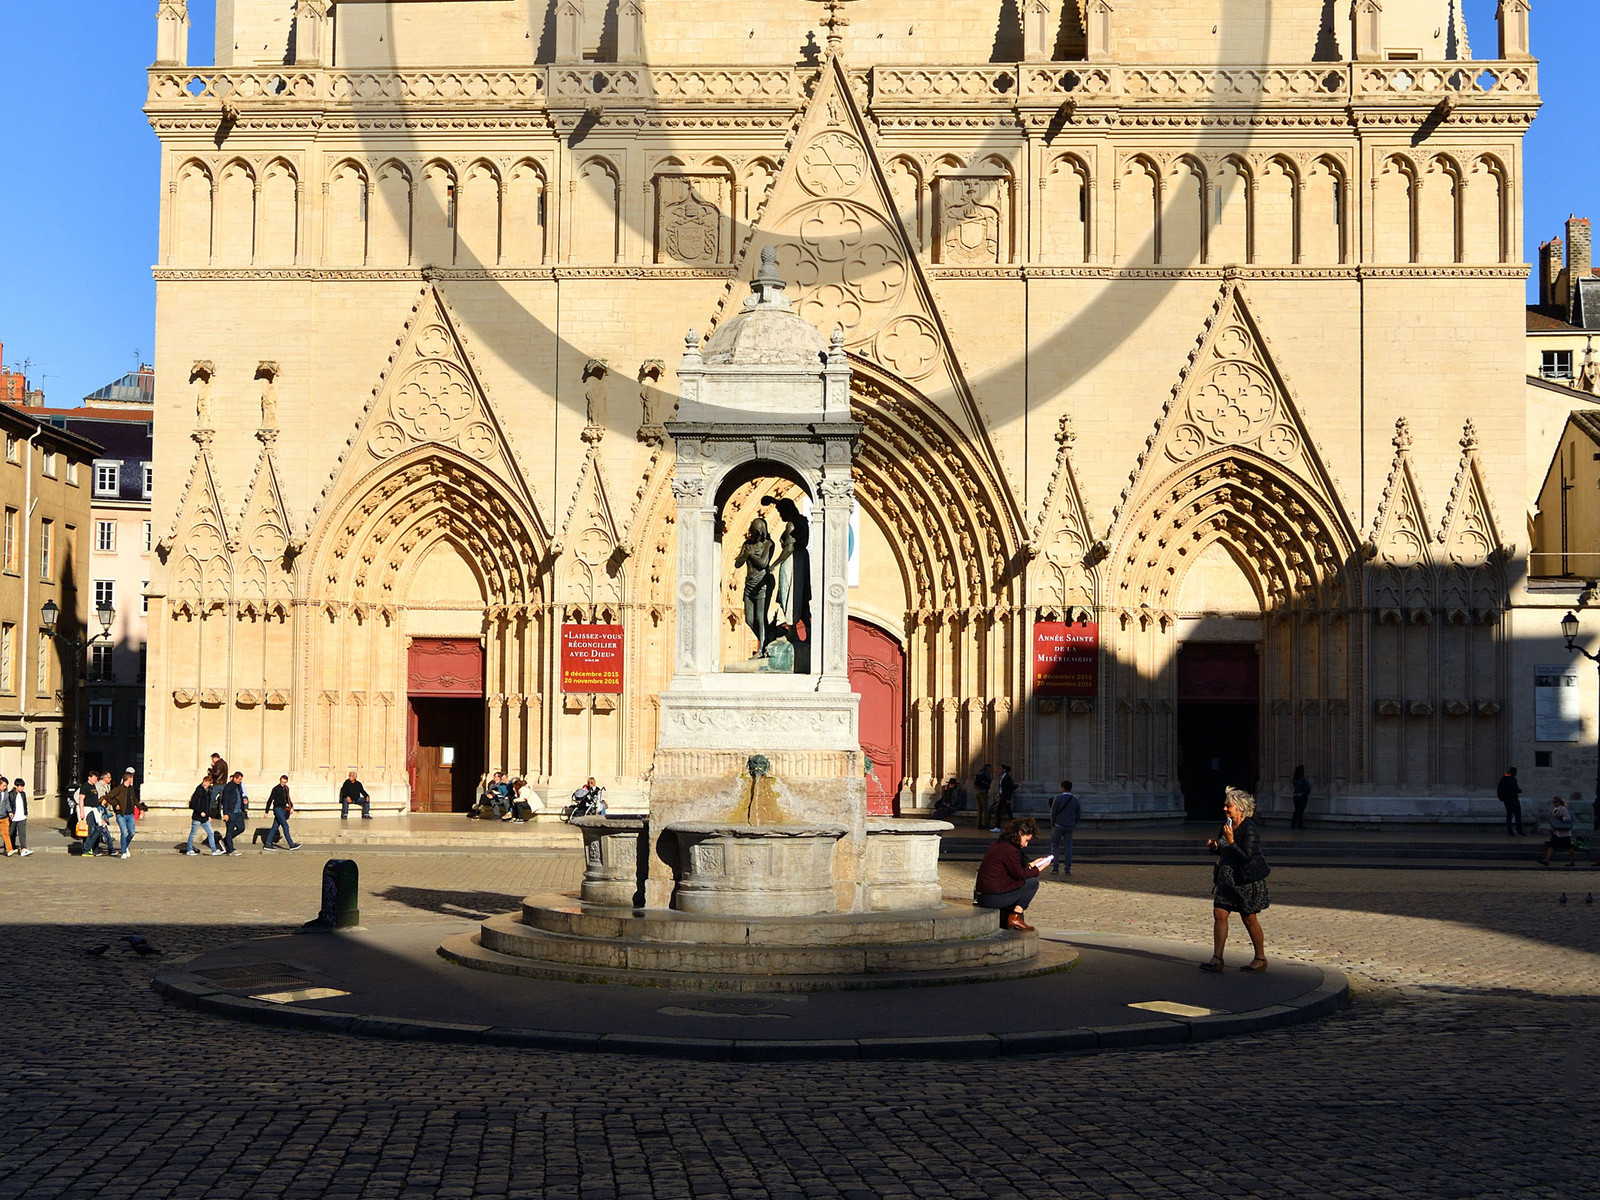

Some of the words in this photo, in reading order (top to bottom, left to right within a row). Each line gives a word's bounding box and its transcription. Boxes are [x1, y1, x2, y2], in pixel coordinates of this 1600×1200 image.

[1038, 633, 1064, 642] ANNÉE
[1065, 634, 1094, 642] SAINTE
[568, 641, 617, 649] RÉCONCILIER
